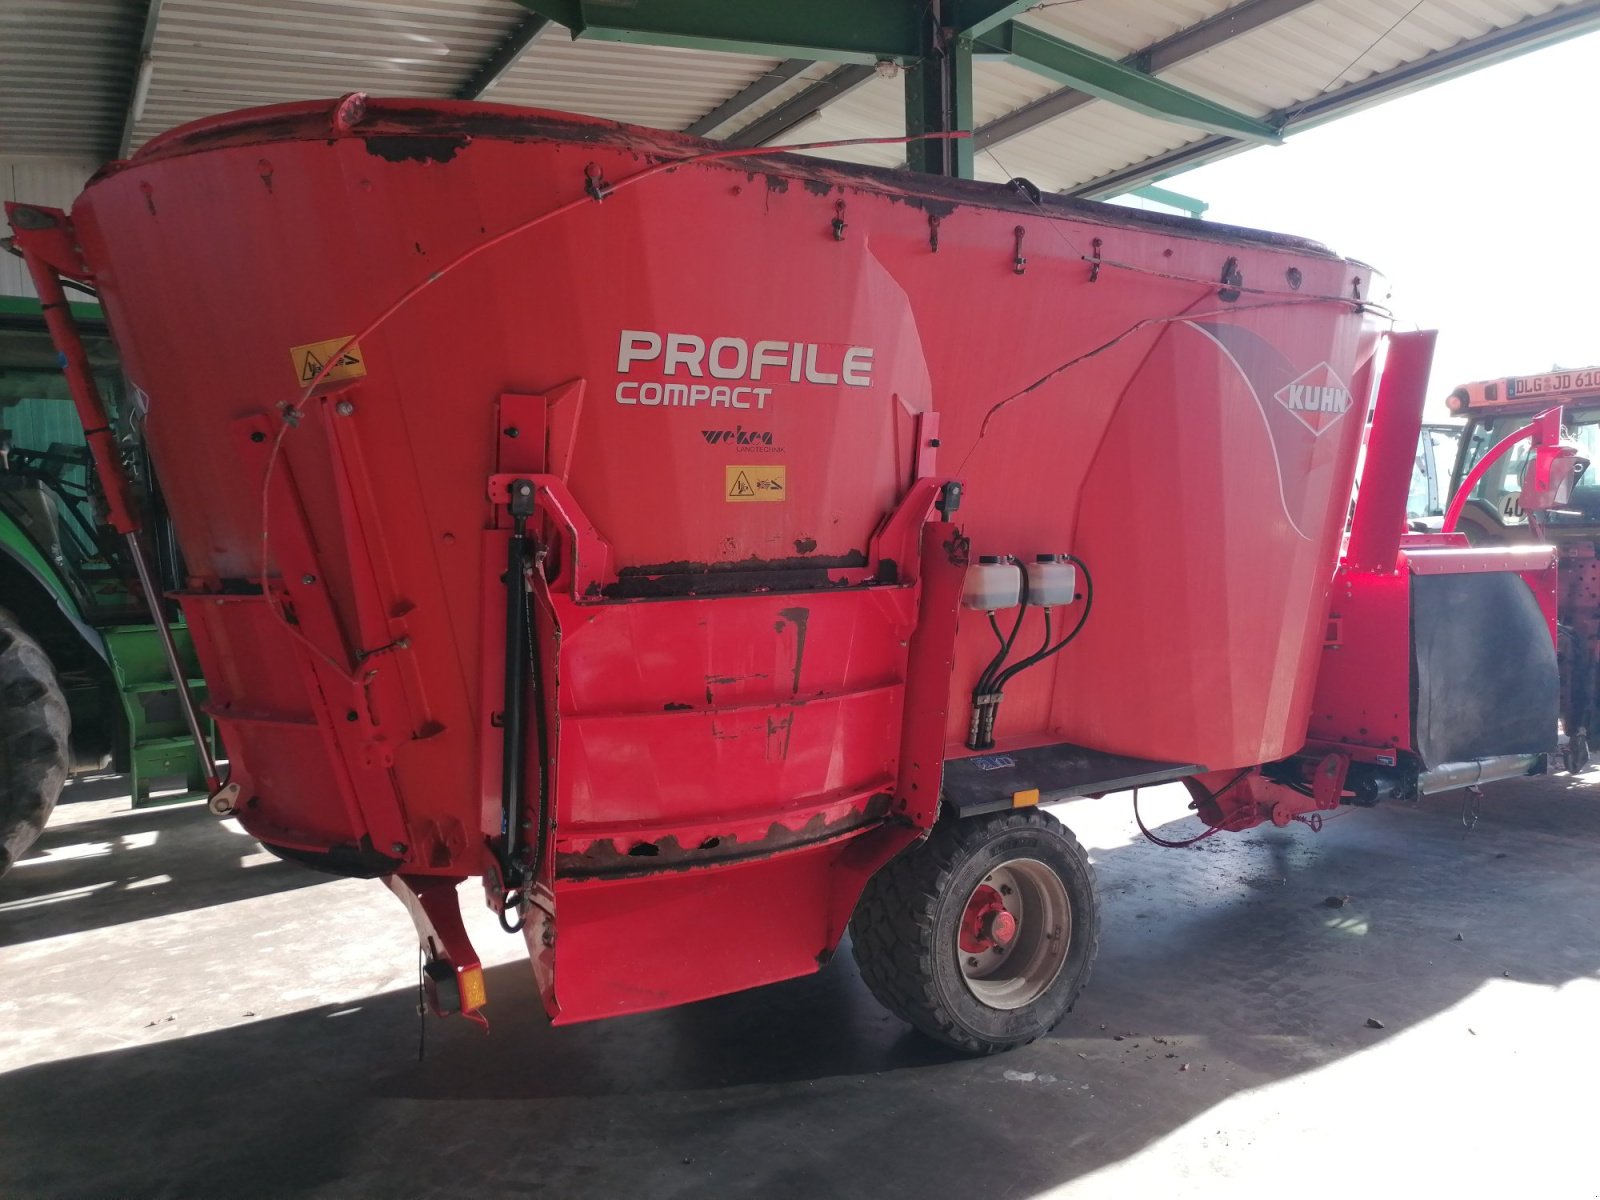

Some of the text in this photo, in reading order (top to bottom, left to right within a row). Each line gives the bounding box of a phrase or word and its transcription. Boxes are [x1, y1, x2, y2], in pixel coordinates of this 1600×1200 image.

[617, 329, 874, 387] PROFILE
[615, 381, 773, 409] COMPACT
[1516, 378, 1542, 394] DLG
[1553, 374, 1571, 390] JD
[1288, 384, 1348, 413] KUHN
